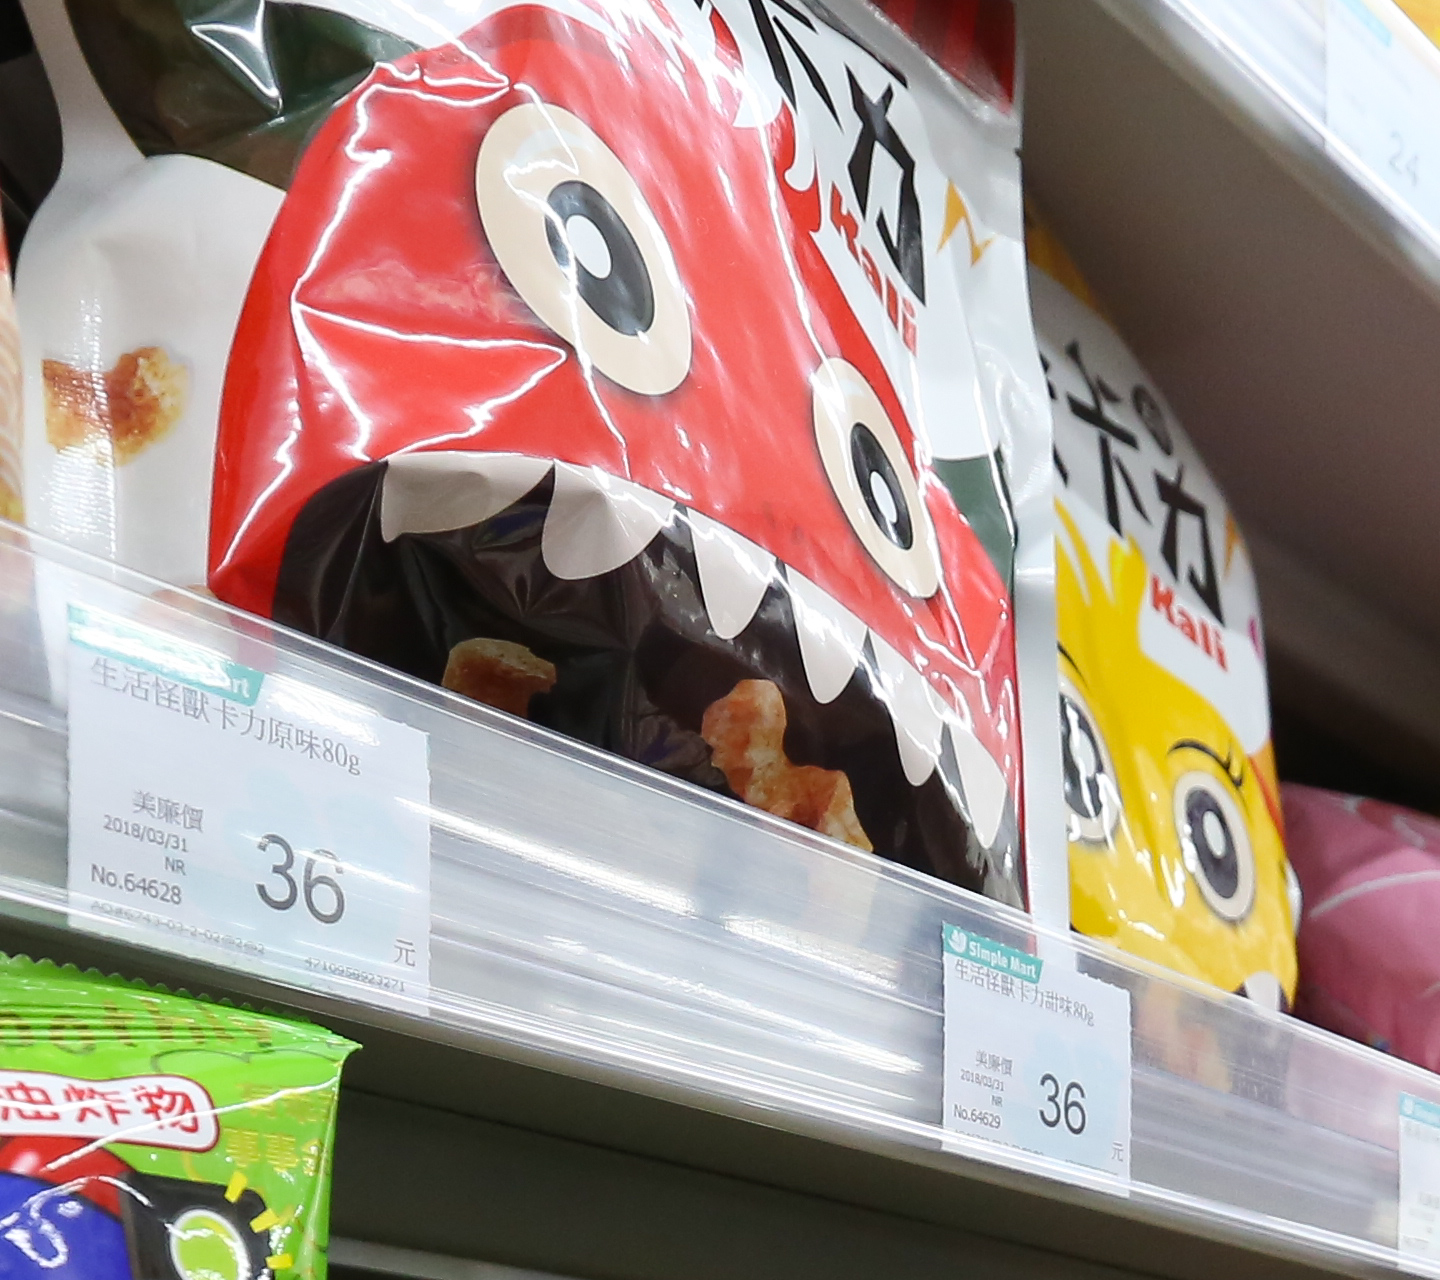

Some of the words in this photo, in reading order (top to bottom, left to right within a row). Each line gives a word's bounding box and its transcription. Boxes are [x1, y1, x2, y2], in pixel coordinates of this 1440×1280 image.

[830, 180, 919, 358] Kali
[1063, 340, 1227, 627] 卡力
[1149, 572, 1231, 673] Kali
[89, 655, 363, 778] 生活怪獸卡力原味80g
[102, 814, 189, 853] 2018/03/31
[131, 789, 205, 834] 美廉價
[90, 861, 183, 906] No.64628
[164, 855, 187, 877] NR
[255, 832, 346, 926] 36
[393, 936, 417, 970] 元
[968, 940, 1009, 971] Simple
[1009, 952, 1038, 979] Mart
[952, 1102, 1002, 1131] No.64629
[1038, 1071, 1088, 1136] 36
